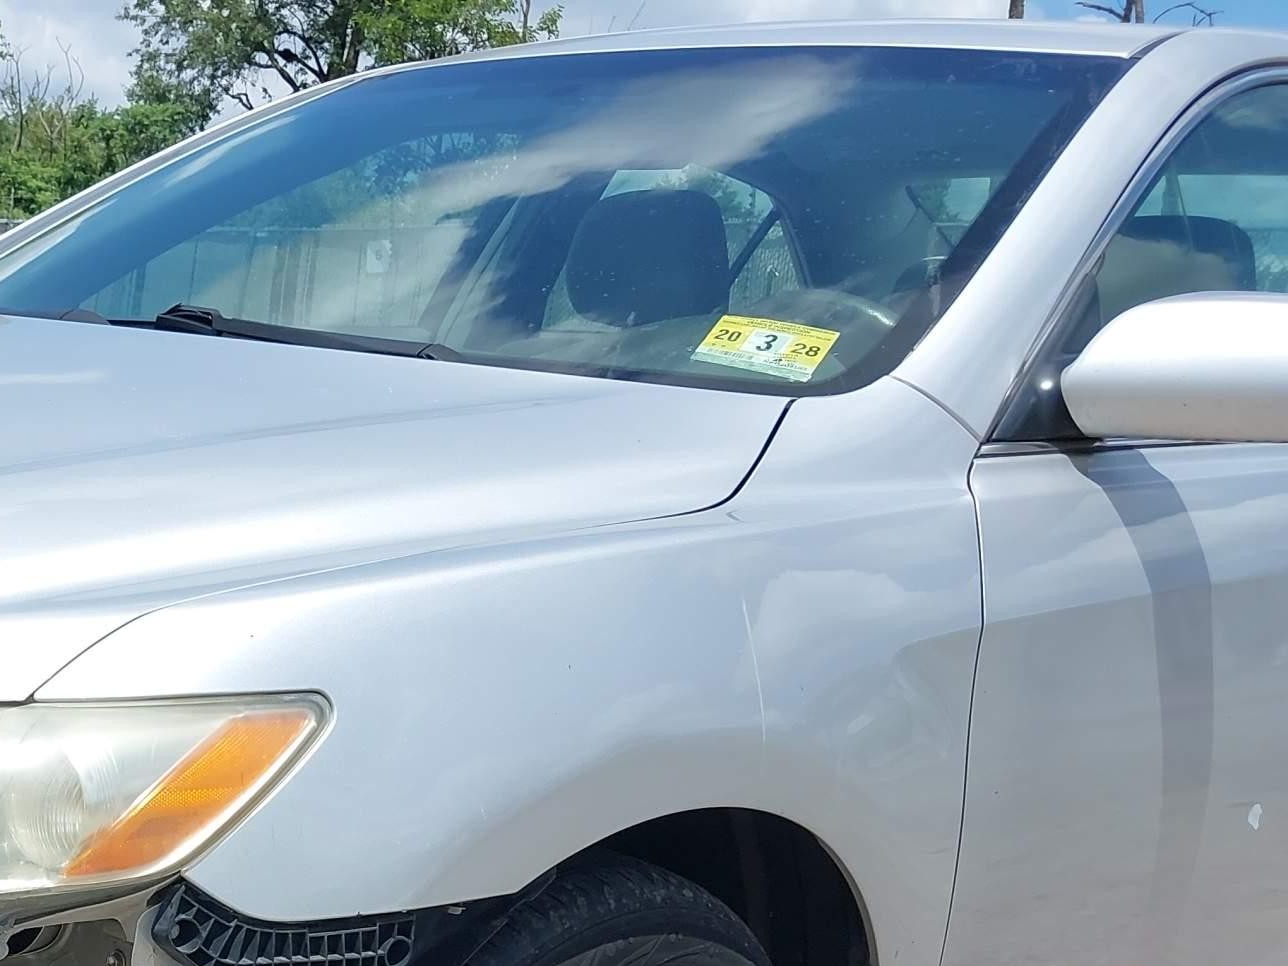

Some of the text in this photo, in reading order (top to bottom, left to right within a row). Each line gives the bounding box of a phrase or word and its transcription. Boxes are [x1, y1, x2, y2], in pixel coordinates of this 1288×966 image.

[714, 329, 742, 342] 20
[756, 334, 778, 351] 3
[790, 343, 821, 357] 28
